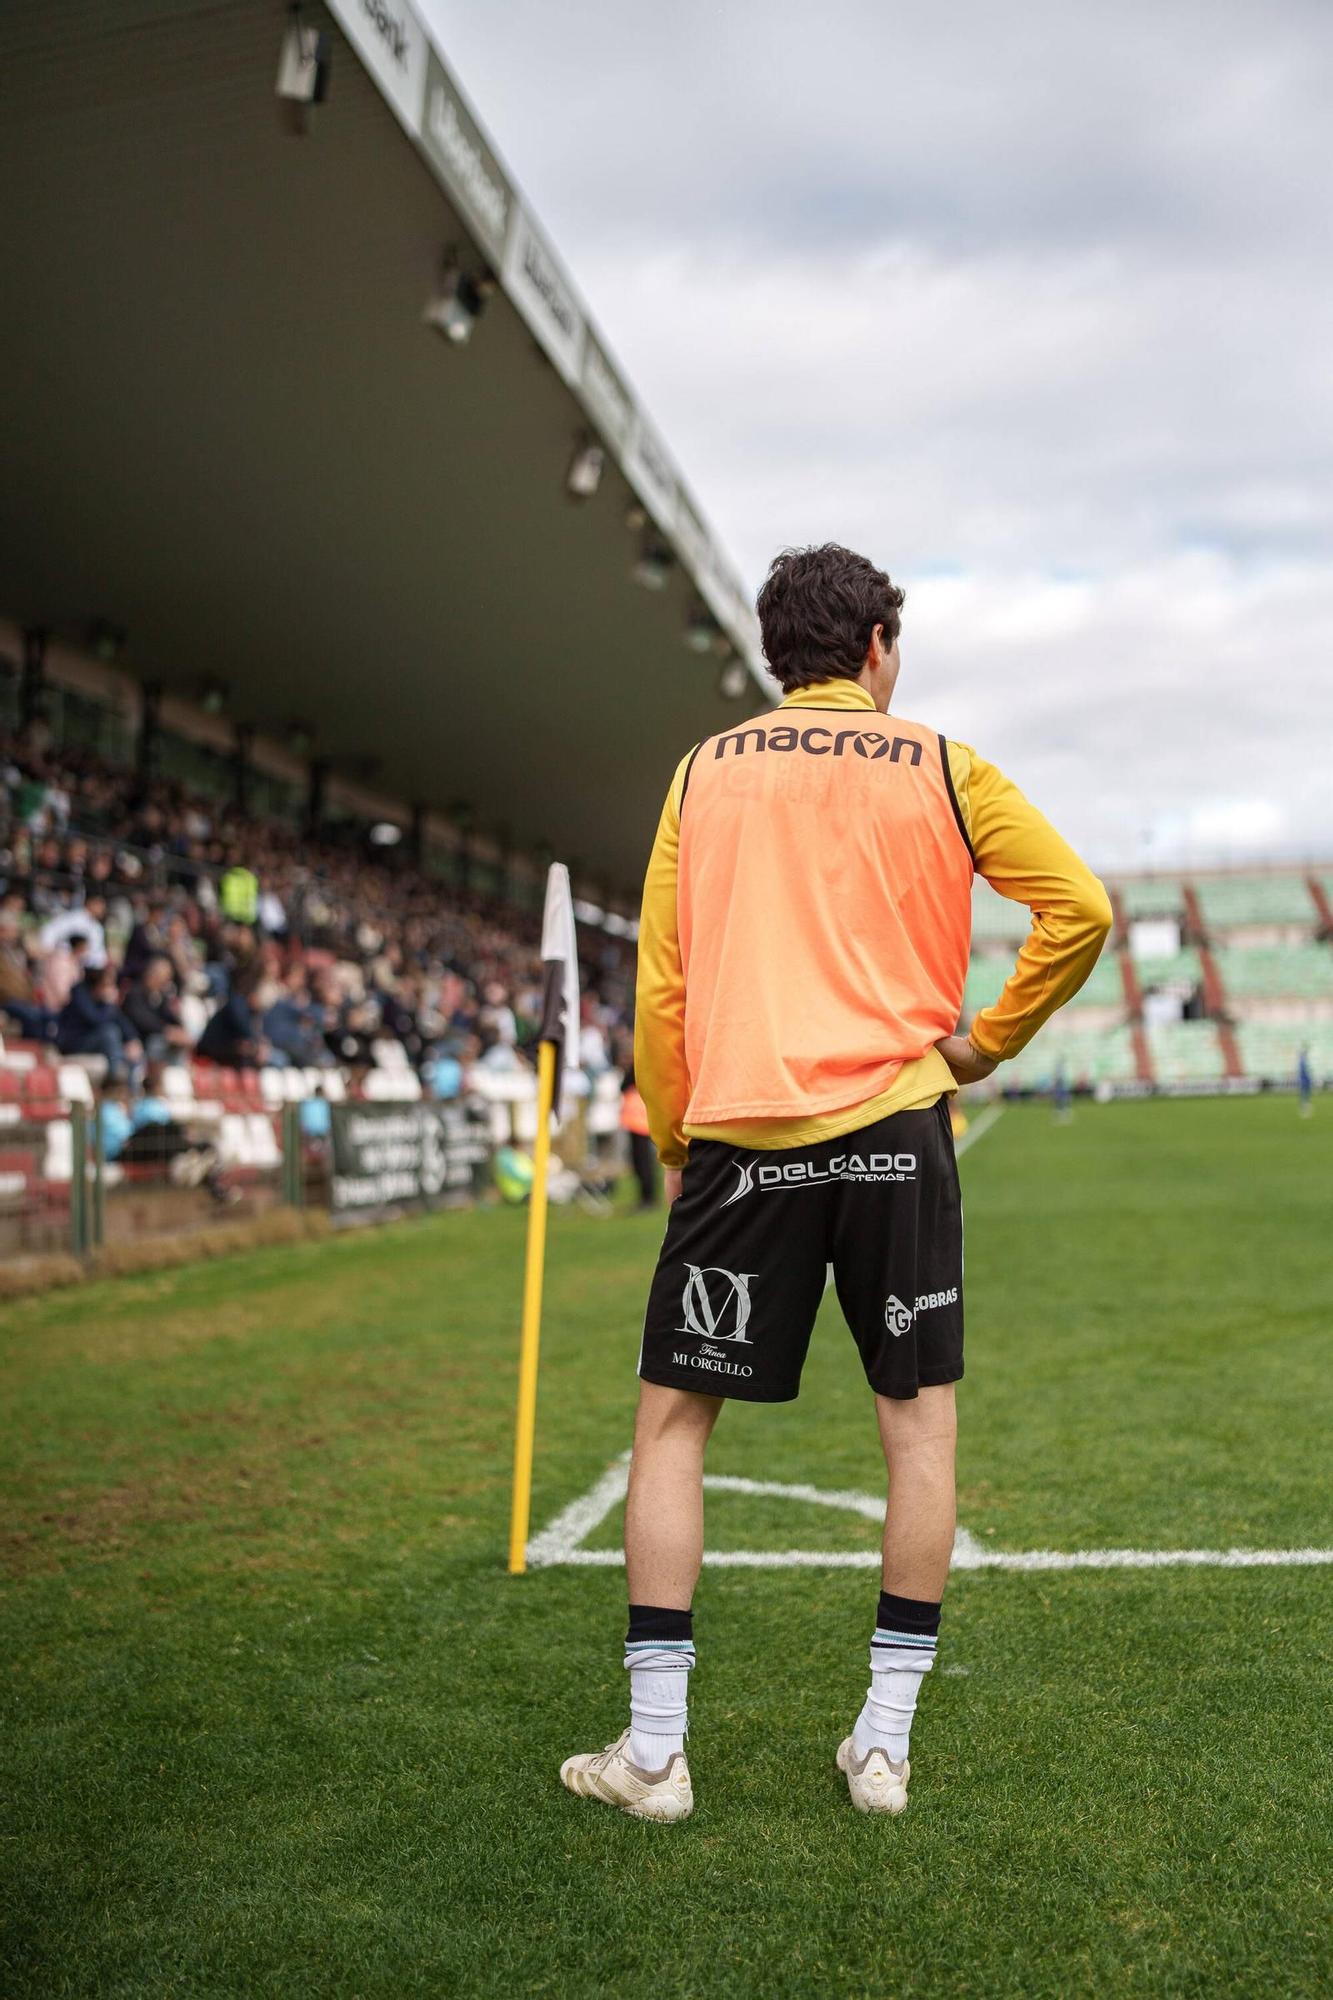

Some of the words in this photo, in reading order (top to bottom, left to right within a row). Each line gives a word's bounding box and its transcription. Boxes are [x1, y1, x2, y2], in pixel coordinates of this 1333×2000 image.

[715, 726, 923, 767] macron
[699, 1342, 727, 1359] Finca
[671, 1351, 688, 1366] MI
[690, 1355, 753, 1378] ORGULLO
